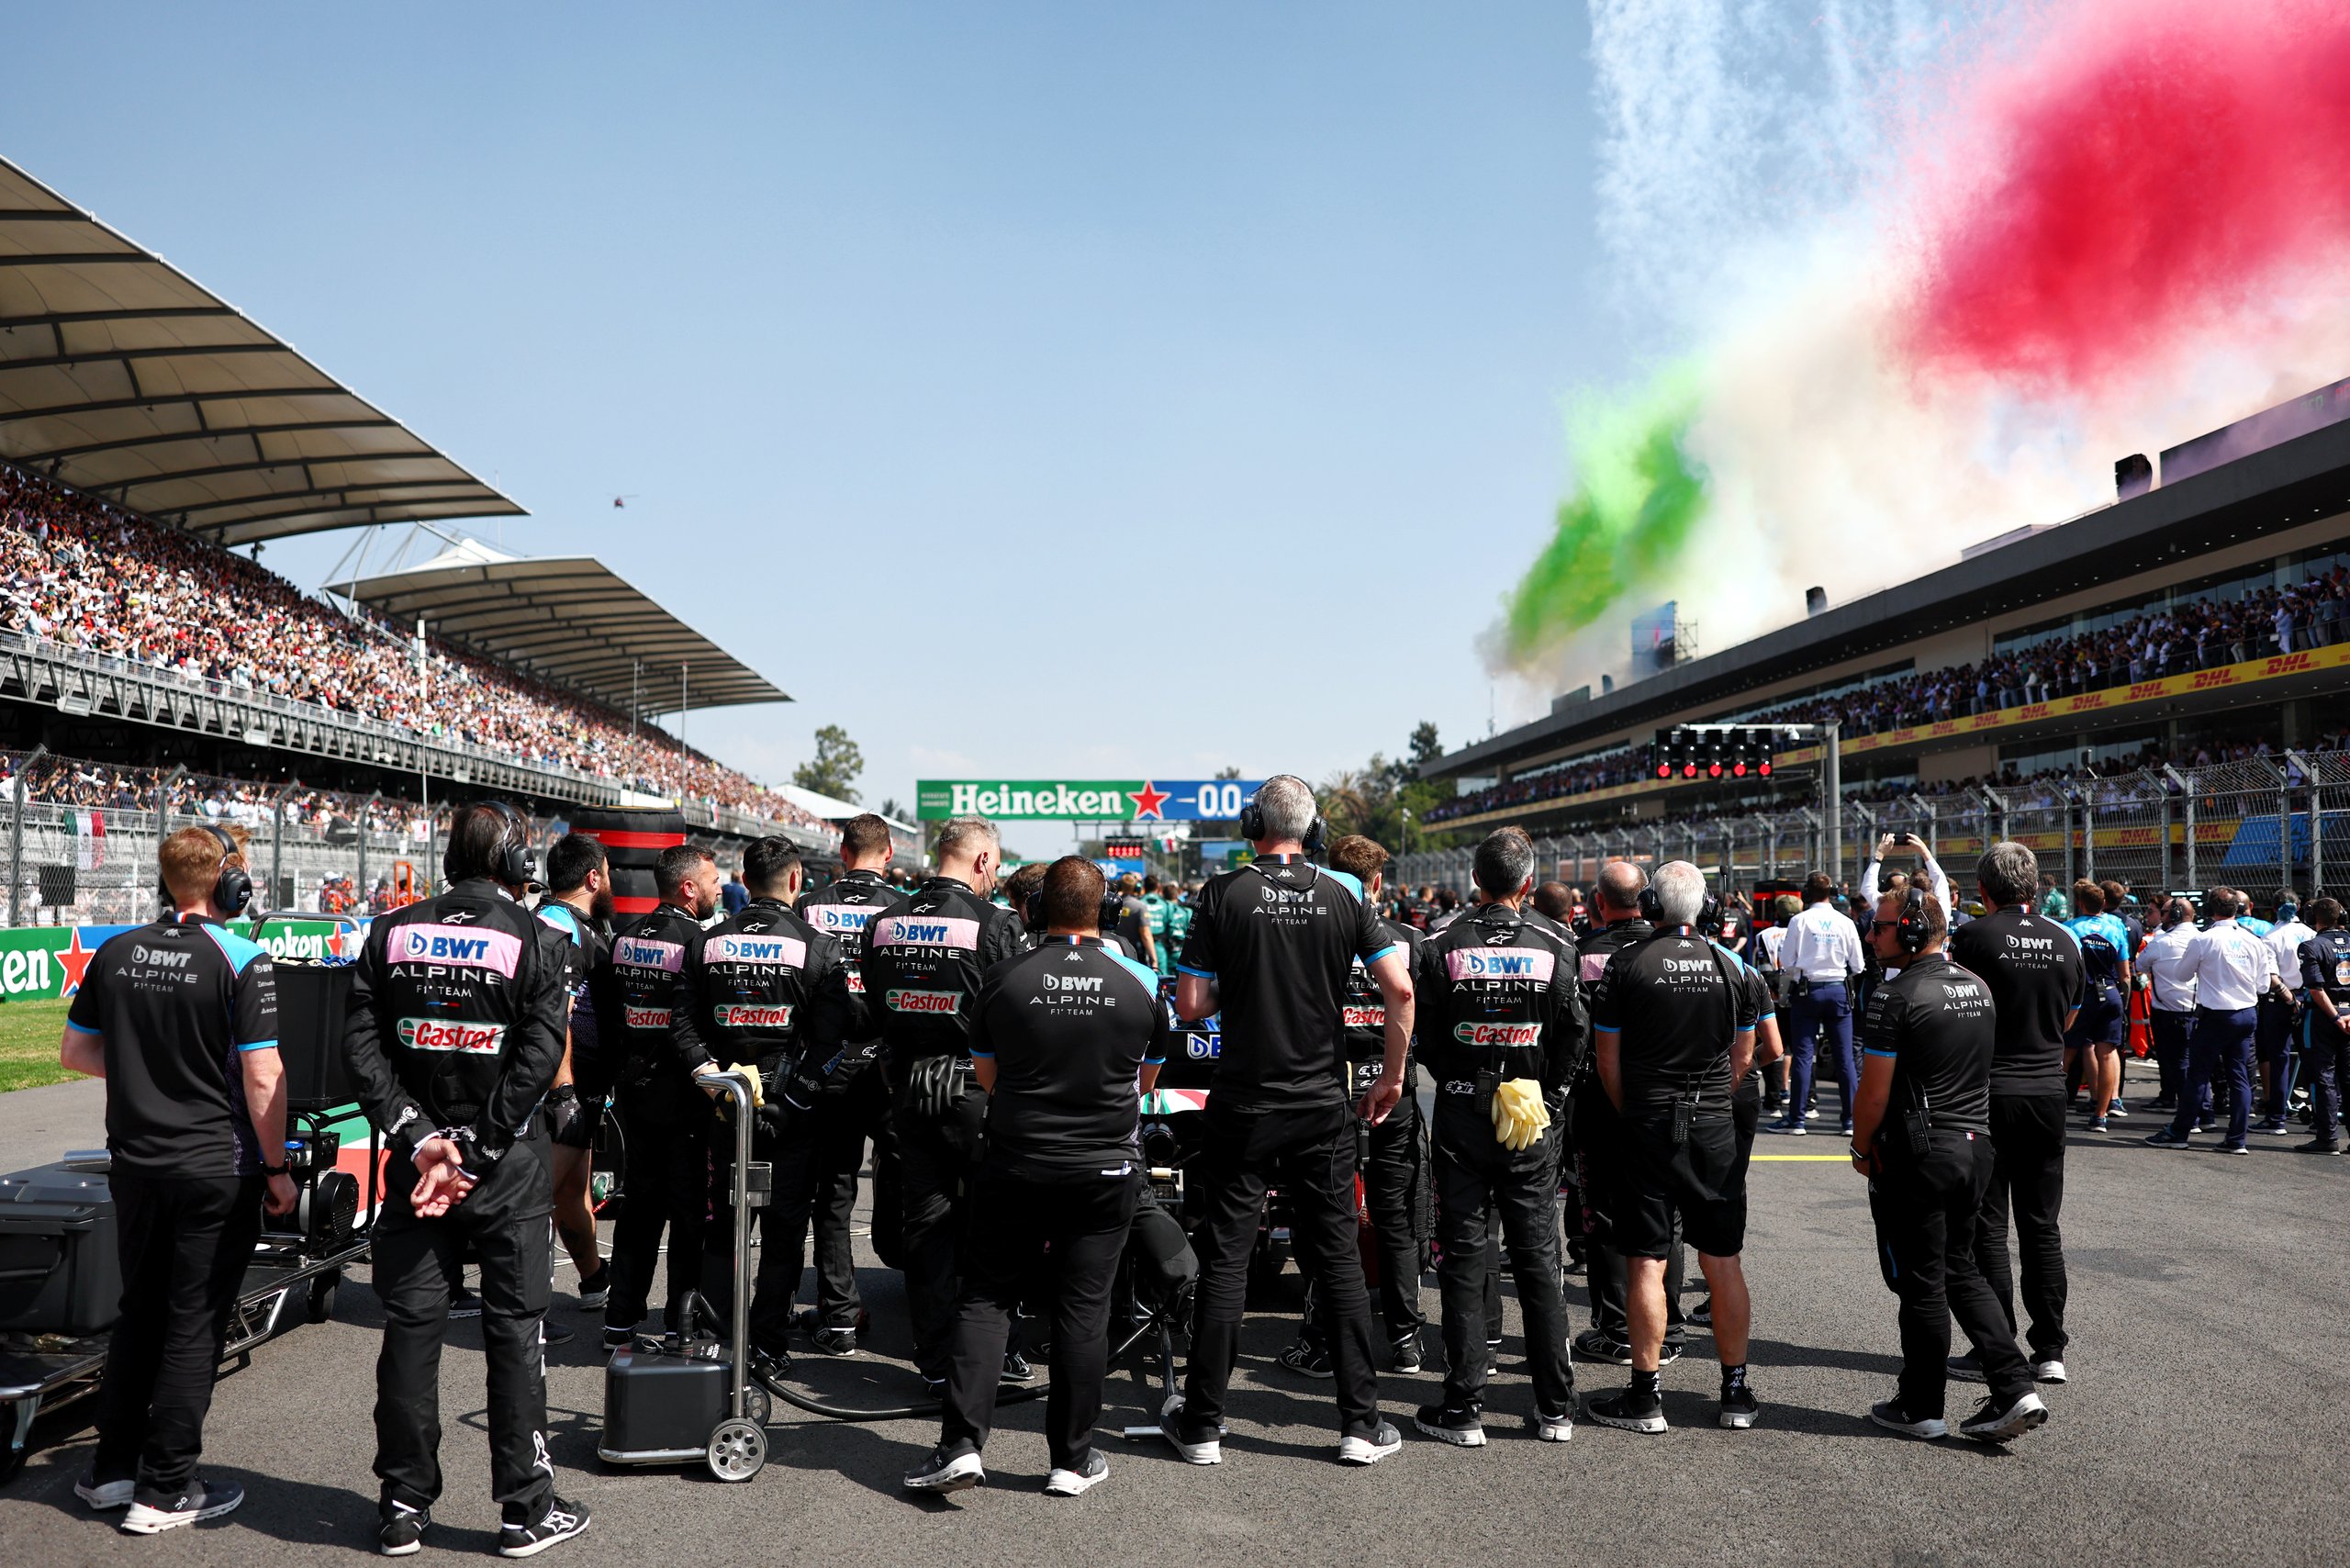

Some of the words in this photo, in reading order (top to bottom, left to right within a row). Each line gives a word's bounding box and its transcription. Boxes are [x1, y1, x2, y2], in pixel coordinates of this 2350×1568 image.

[2266, 653, 2311, 675] DHL
[2194, 668, 2232, 689] DHL
[2130, 681, 2164, 700] DHL
[2072, 694, 2102, 711] DHL
[2020, 704, 2048, 720] DHL
[1974, 713, 1999, 728] DHL
[1931, 722, 1955, 735] DHL
[950, 783, 1124, 815] Heineken
[1252, 906, 1327, 916] ALPINE
[907, 924, 947, 942] BWT
[431, 936, 489, 960] BWT
[740, 942, 783, 959] BWT
[2021, 937, 2053, 950] BWT
[149, 948, 192, 968] BWT
[633, 946, 666, 966] BWT
[880, 946, 960, 959] ALPINE
[1998, 952, 2065, 962] ALPINE
[709, 965, 792, 977] ALPINE
[911, 962, 936, 971] TEAM
[1488, 957, 1534, 974] BWT
[1680, 959, 1713, 972] BWT
[115, 967, 199, 984] ALPINE
[390, 965, 502, 986] ALPINE
[615, 966, 672, 981] ALPINE
[1654, 975, 1725, 985] ALPINE
[151, 983, 174, 992] TEAM
[744, 979, 770, 988] TEAM
[1061, 976, 1103, 991] BWT
[1452, 980, 1548, 993] ALPINE
[1957, 984, 1980, 998] BWT
[438, 986, 472, 998] TEAM
[901, 991, 956, 1012] Castrol
[1029, 995, 1116, 1007] ALPINE
[1494, 996, 1522, 1004] TEAM
[1943, 999, 1991, 1011] ALPINE
[729, 1006, 788, 1025] Castrol
[1067, 1008, 1093, 1016] TEAM
[1343, 1007, 1385, 1025] Castro
[415, 1022, 498, 1049] Castrol
[1474, 1025, 1539, 1044] Castrol
